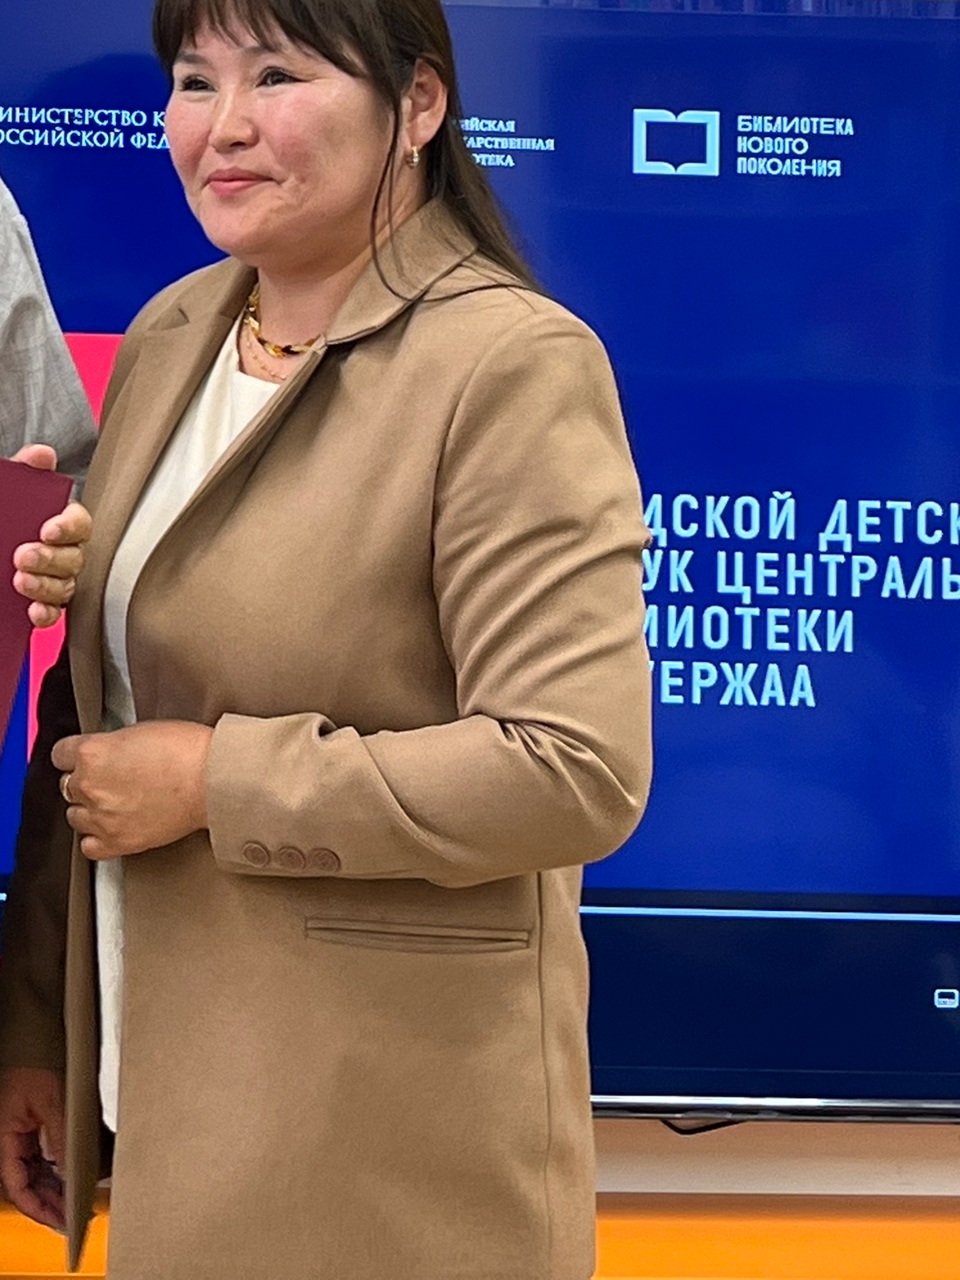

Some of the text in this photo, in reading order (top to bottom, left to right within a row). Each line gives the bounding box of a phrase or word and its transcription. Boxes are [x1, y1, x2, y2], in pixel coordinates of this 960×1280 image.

[737, 114, 854, 136] БИБЛИОТЕКА
[463, 136, 555, 151] АРСТВЕННАЯ
[737, 136, 809, 155] НОВОГО
[737, 157, 842, 177] ПОКОЛЕНИЯ
[716, 550, 960, 605] ЦЕНТРАЛЬ
[648, 660, 816, 707] ЕРЖАА
